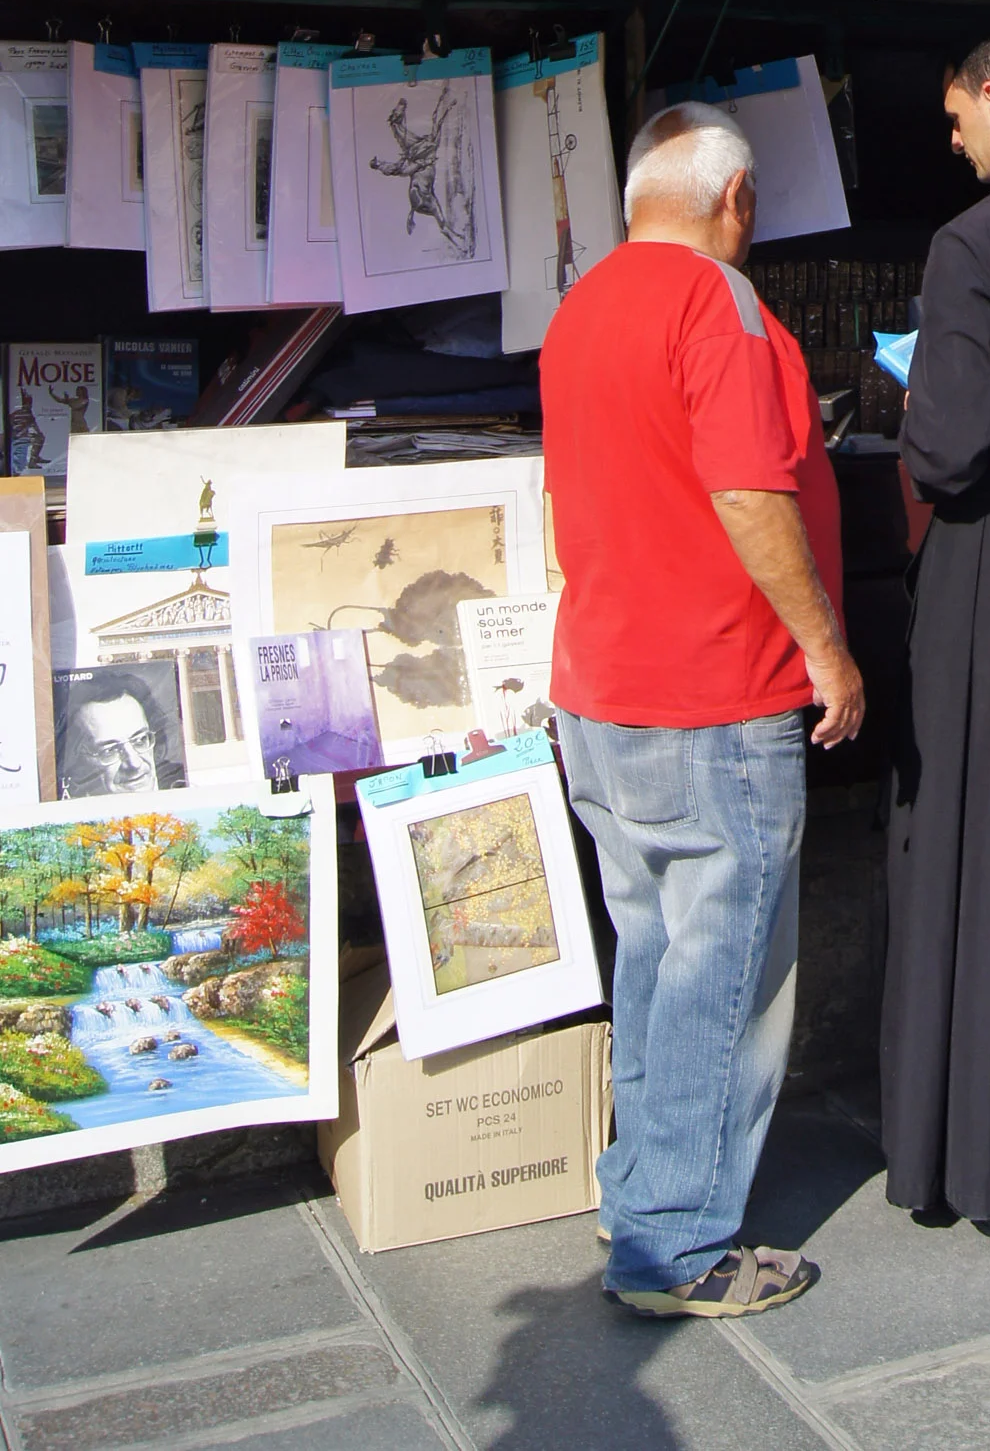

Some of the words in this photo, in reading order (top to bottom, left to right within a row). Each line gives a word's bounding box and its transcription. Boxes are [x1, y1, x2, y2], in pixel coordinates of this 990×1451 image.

[114, 341, 155, 353] NICOLAS
[158, 342, 192, 353] VANIER
[18, 356, 96, 387] MOÏSE
[476, 606, 494, 616] un
[498, 602, 547, 615] monde
[478, 617, 513, 627] sous
[480, 629, 492, 640] la
[496, 627, 525, 639] mer
[257, 644, 296, 664] FRESNES
[53, 672, 93, 683] LYOTARD
[259, 665, 271, 682] LA
[270, 663, 299, 681] PRISON
[425, 1099, 453, 1118] SET
[456, 1095, 479, 1113] WC
[482, 1079, 564, 1109] ECONOMICO
[476, 1114, 501, 1128] PCS
[503, 1112, 517, 1123] 24
[470, 1132, 492, 1142] MADE
[493, 1130, 501, 1138] IN
[502, 1126, 523, 1137] ITALY
[424, 1169, 486, 1202] QUALITÀ
[491, 1156, 569, 1188] SUPERIORE
